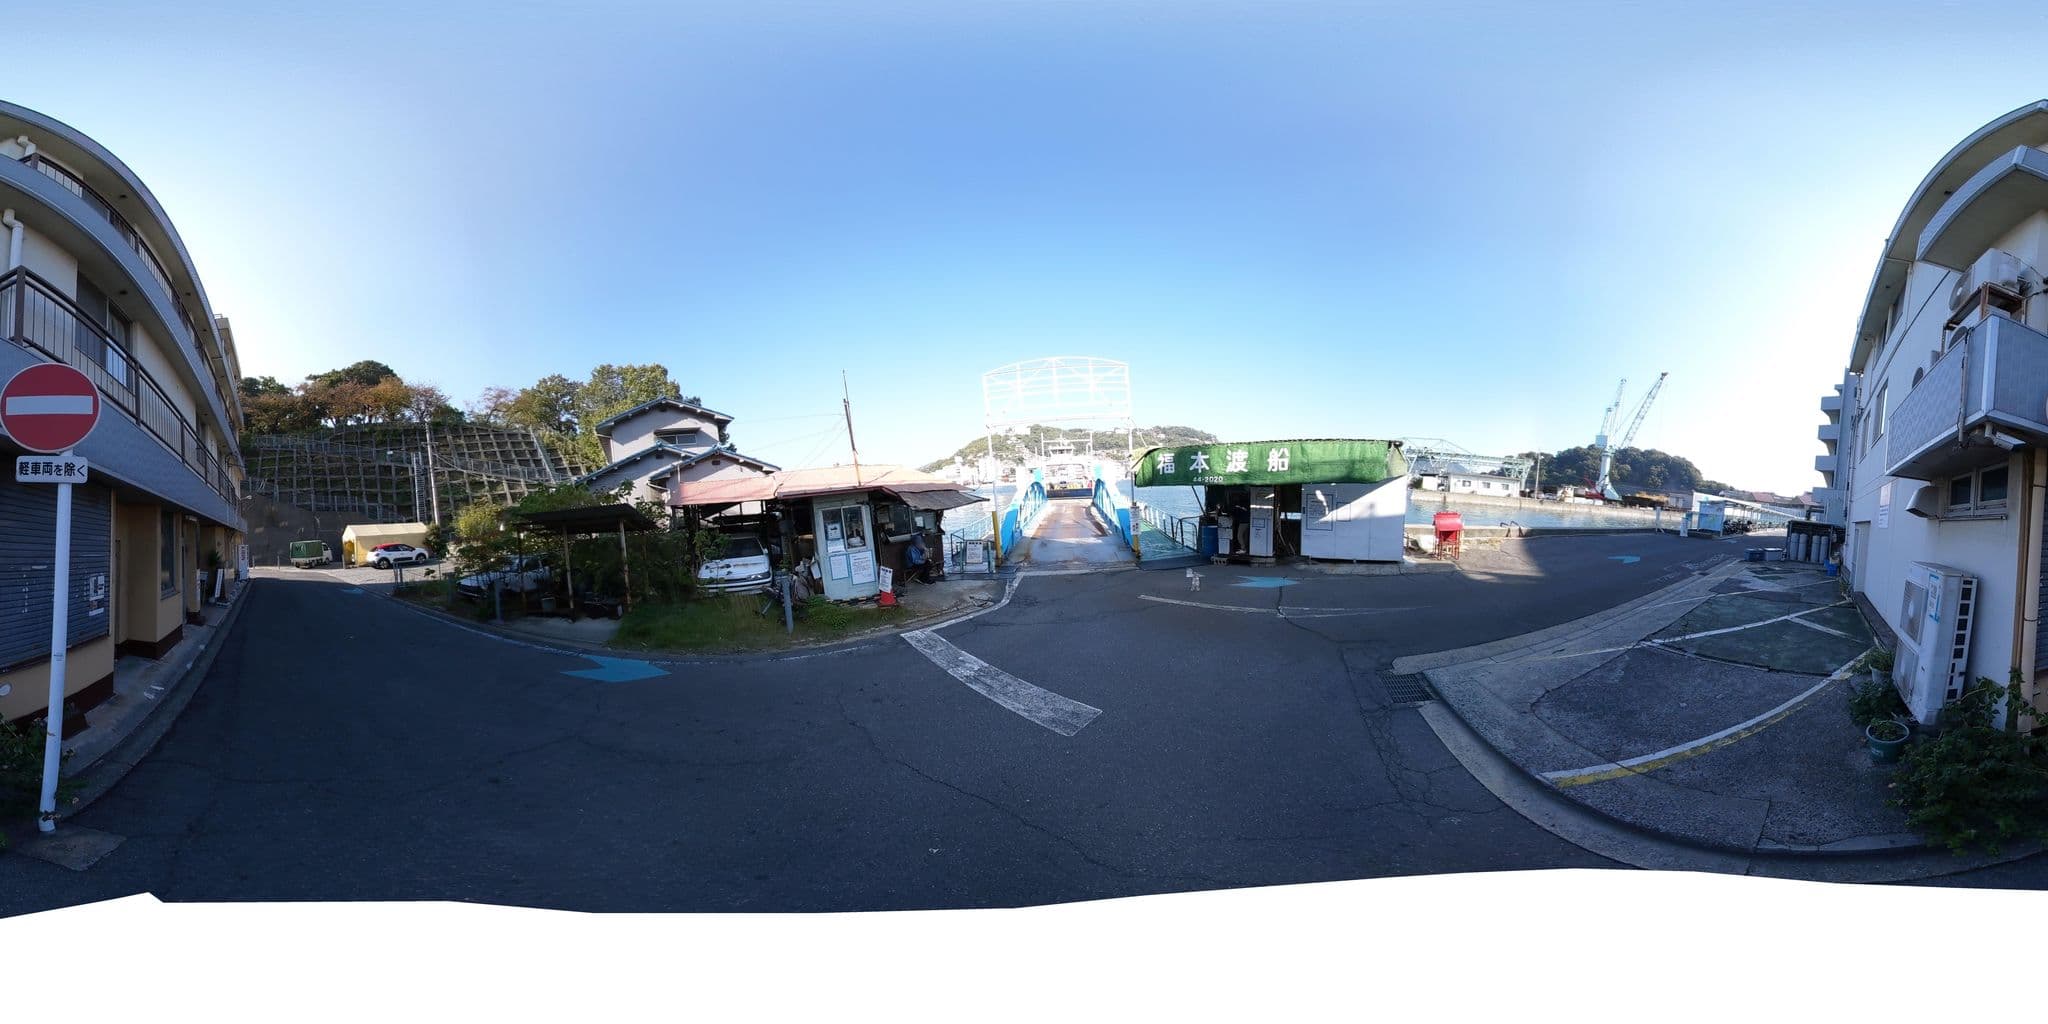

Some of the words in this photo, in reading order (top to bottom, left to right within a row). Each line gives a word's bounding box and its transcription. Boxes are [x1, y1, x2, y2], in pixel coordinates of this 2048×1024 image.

[19, 461, 85, 477] 軽車両を除く
[1157, 448, 1290, 475] 福本渡船
